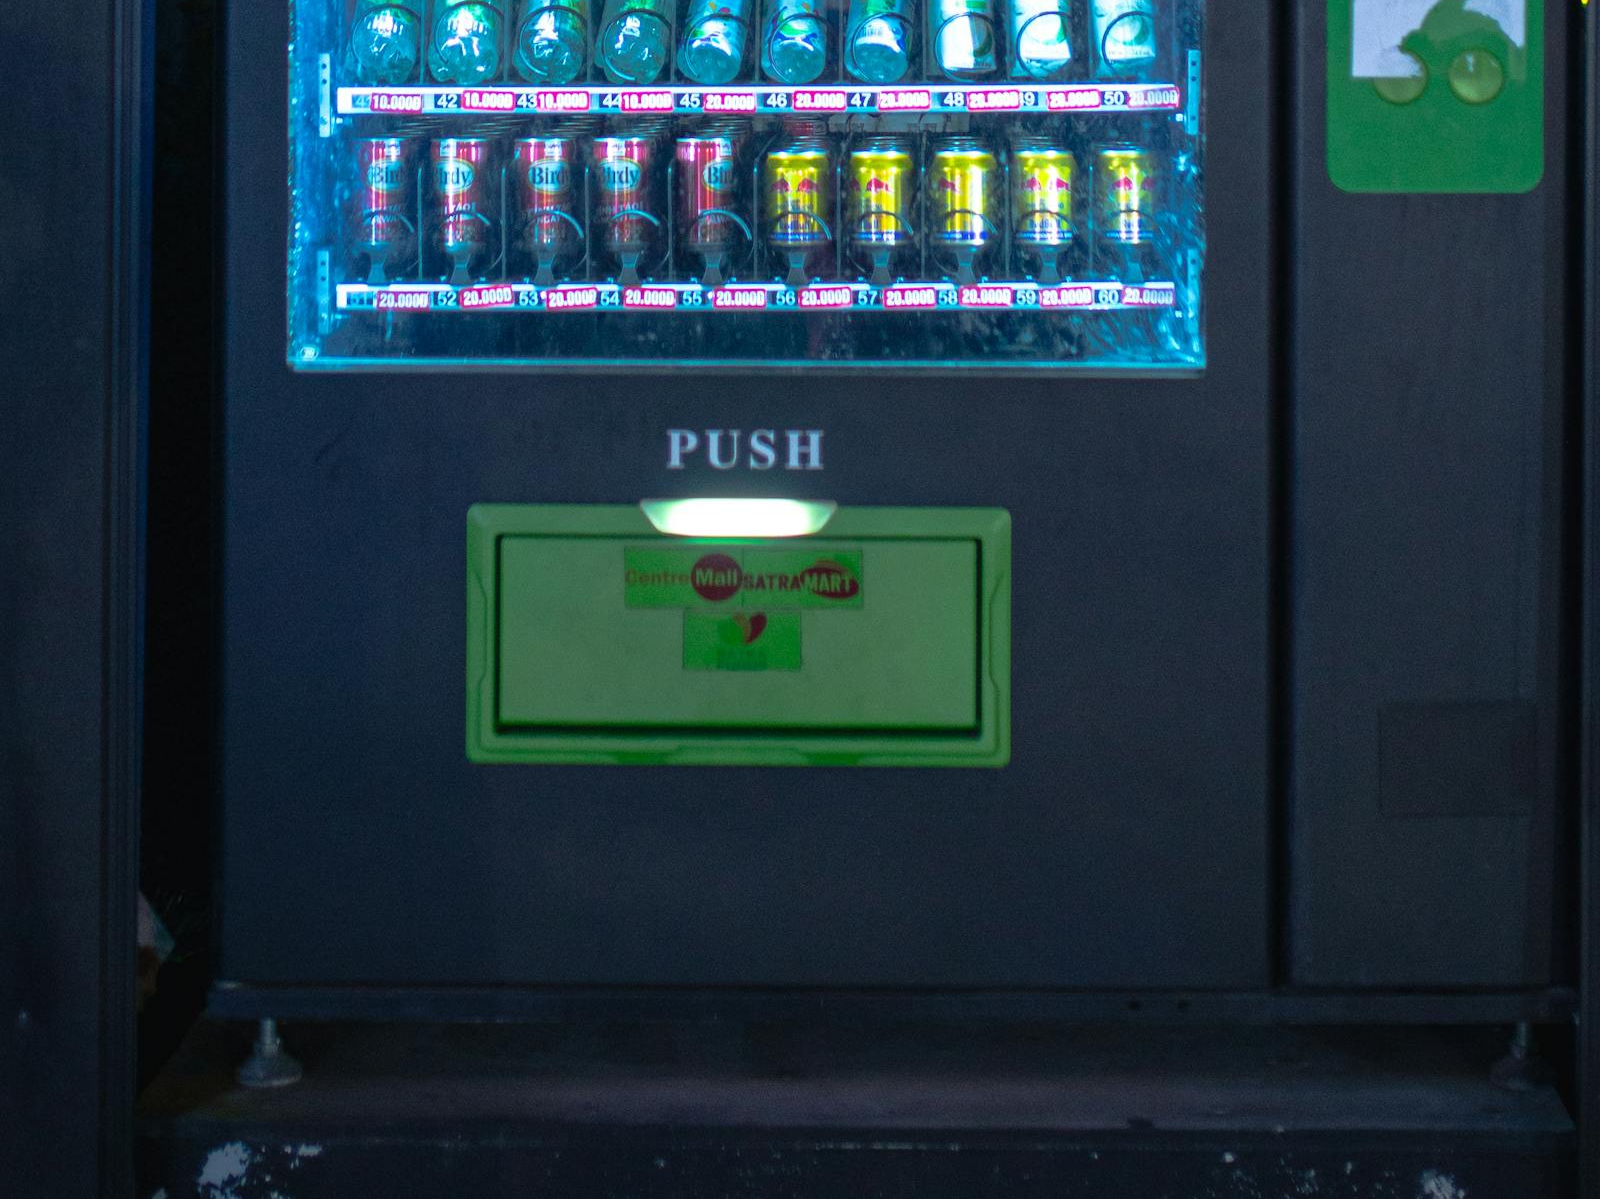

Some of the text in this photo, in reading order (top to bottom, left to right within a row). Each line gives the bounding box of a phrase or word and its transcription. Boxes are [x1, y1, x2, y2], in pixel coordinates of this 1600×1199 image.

[437, 94, 457, 107] 42
[517, 94, 537, 107] 43
[603, 94, 620, 107] 44
[680, 93, 700, 107] 45
[767, 93, 787, 107] 46
[851, 93, 871, 106] 47
[944, 93, 964, 105] 48
[1104, 92, 1124, 104] 50
[438, 293, 456, 305] 52
[519, 293, 538, 305] 53
[601, 293, 620, 305] 54
[683, 292, 702, 304] 55
[776, 291, 795, 304] 56
[859, 291, 877, 304] 57
[939, 290, 957, 304] 58
[1017, 290, 1036, 304] 59
[1098, 290, 1119, 304] 60
[666, 428, 825, 471] PUSH
[625, 567, 739, 588] Centre Mall
[742, 569, 852, 594] SATRA MART
